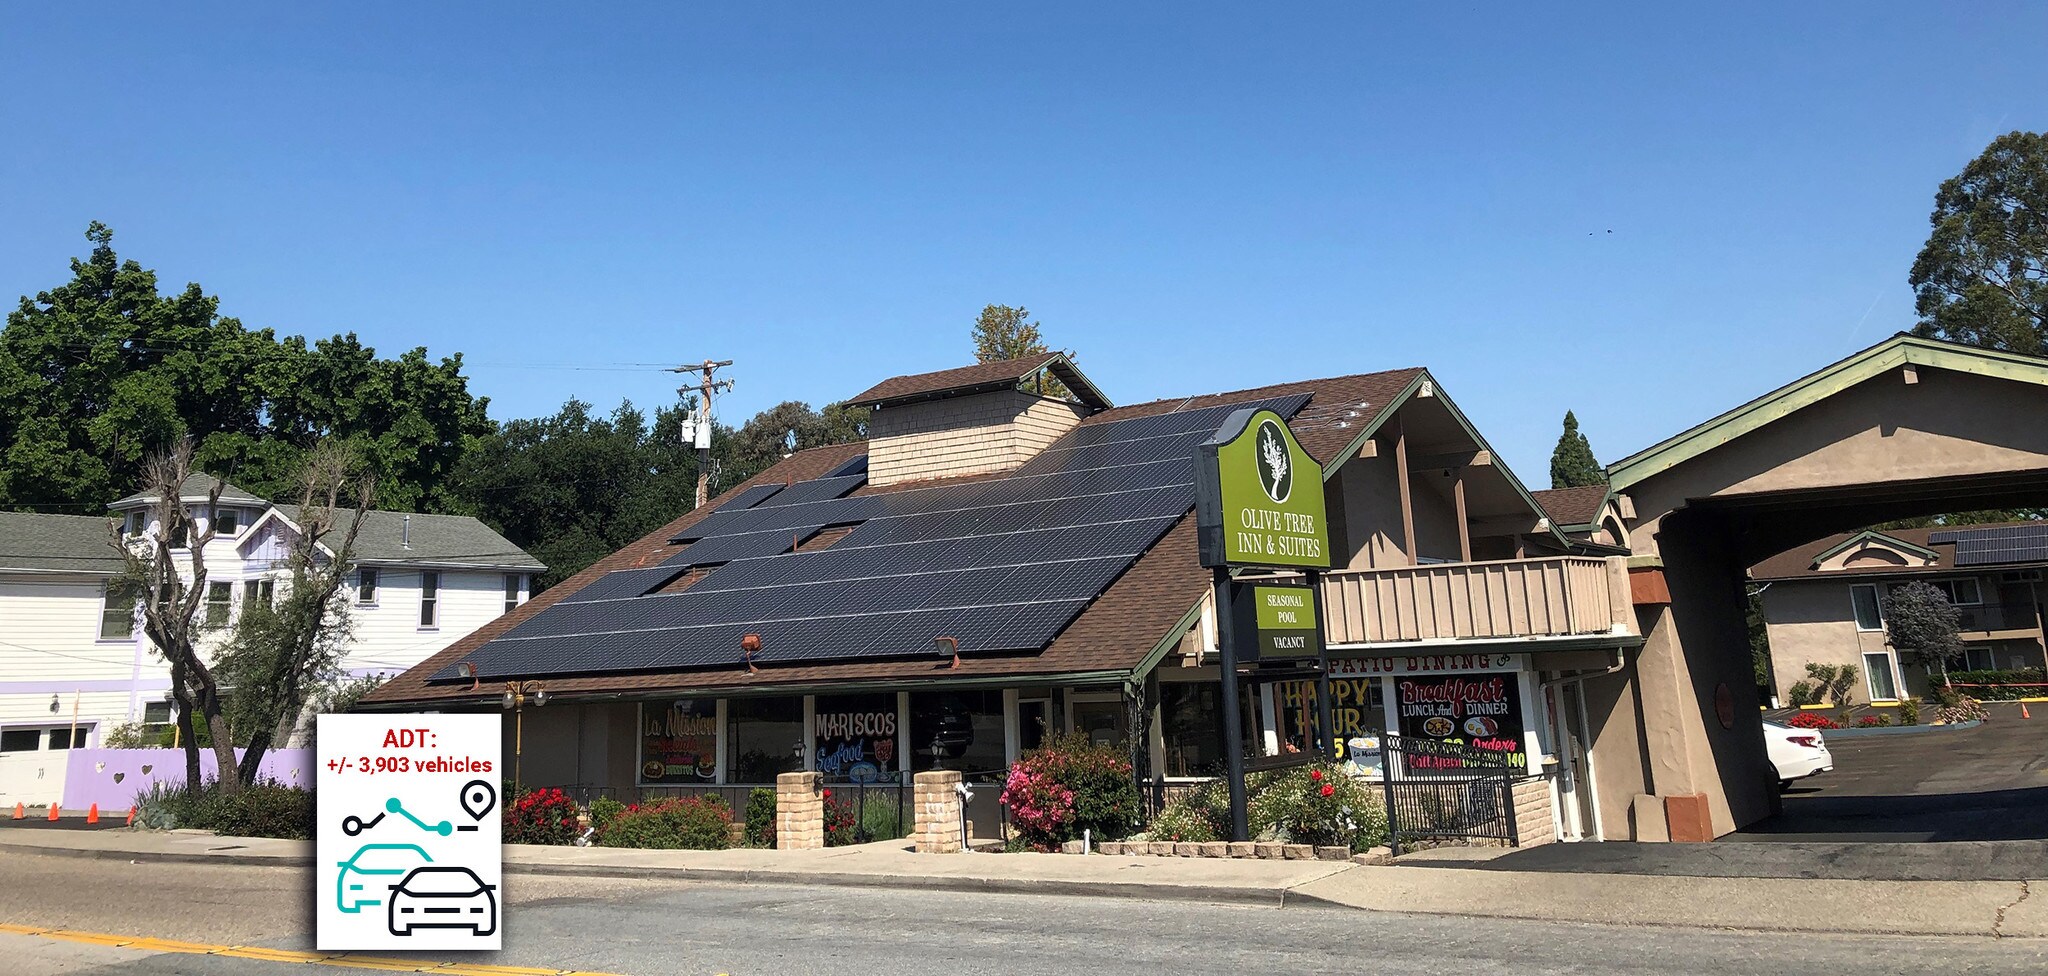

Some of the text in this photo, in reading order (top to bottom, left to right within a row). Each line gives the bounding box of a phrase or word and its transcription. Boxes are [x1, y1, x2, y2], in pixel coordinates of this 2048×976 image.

[1241, 507, 1315, 535] OLIVE TREE
[1237, 531, 1321, 558] INN & SUITES
[1267, 594, 1304, 608] SEASONAL
[1277, 611, 1297, 624] POOL
[1273, 636, 1305, 649] VACANCY
[1328, 653, 1491, 674] PATIO DINING
[1466, 702, 1509, 715] DINNER
[815, 712, 896, 741] MARISCOS
[815, 738, 865, 776] Seafood
